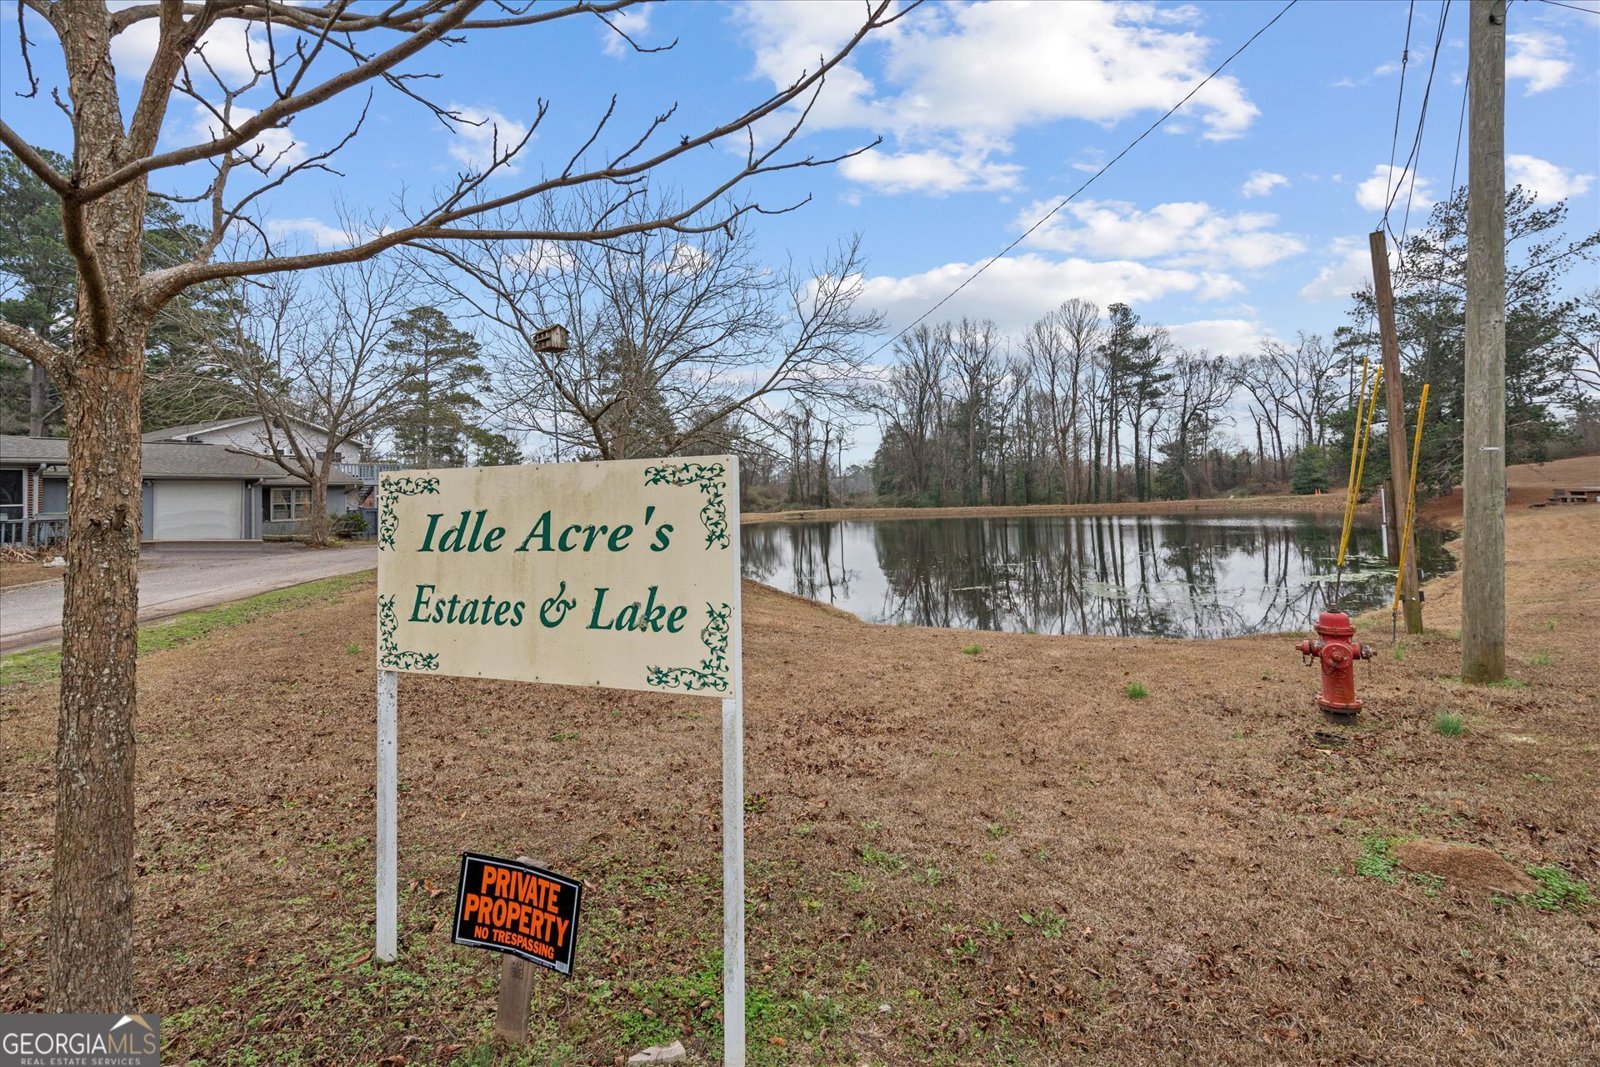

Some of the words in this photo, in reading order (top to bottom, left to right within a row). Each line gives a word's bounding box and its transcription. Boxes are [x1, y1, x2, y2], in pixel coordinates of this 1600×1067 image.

[417, 509, 506, 552] Idle
[514, 505, 674, 552] Acre's
[408, 584, 525, 627] Estates
[539, 580, 577, 628] &
[586, 585, 688, 633] Lake
[481, 865, 561, 914] PRIVATE
[463, 893, 570, 947] PROPERTY
[474, 926, 489, 939] NO
[492, 928, 555, 960] TRESPASSING
